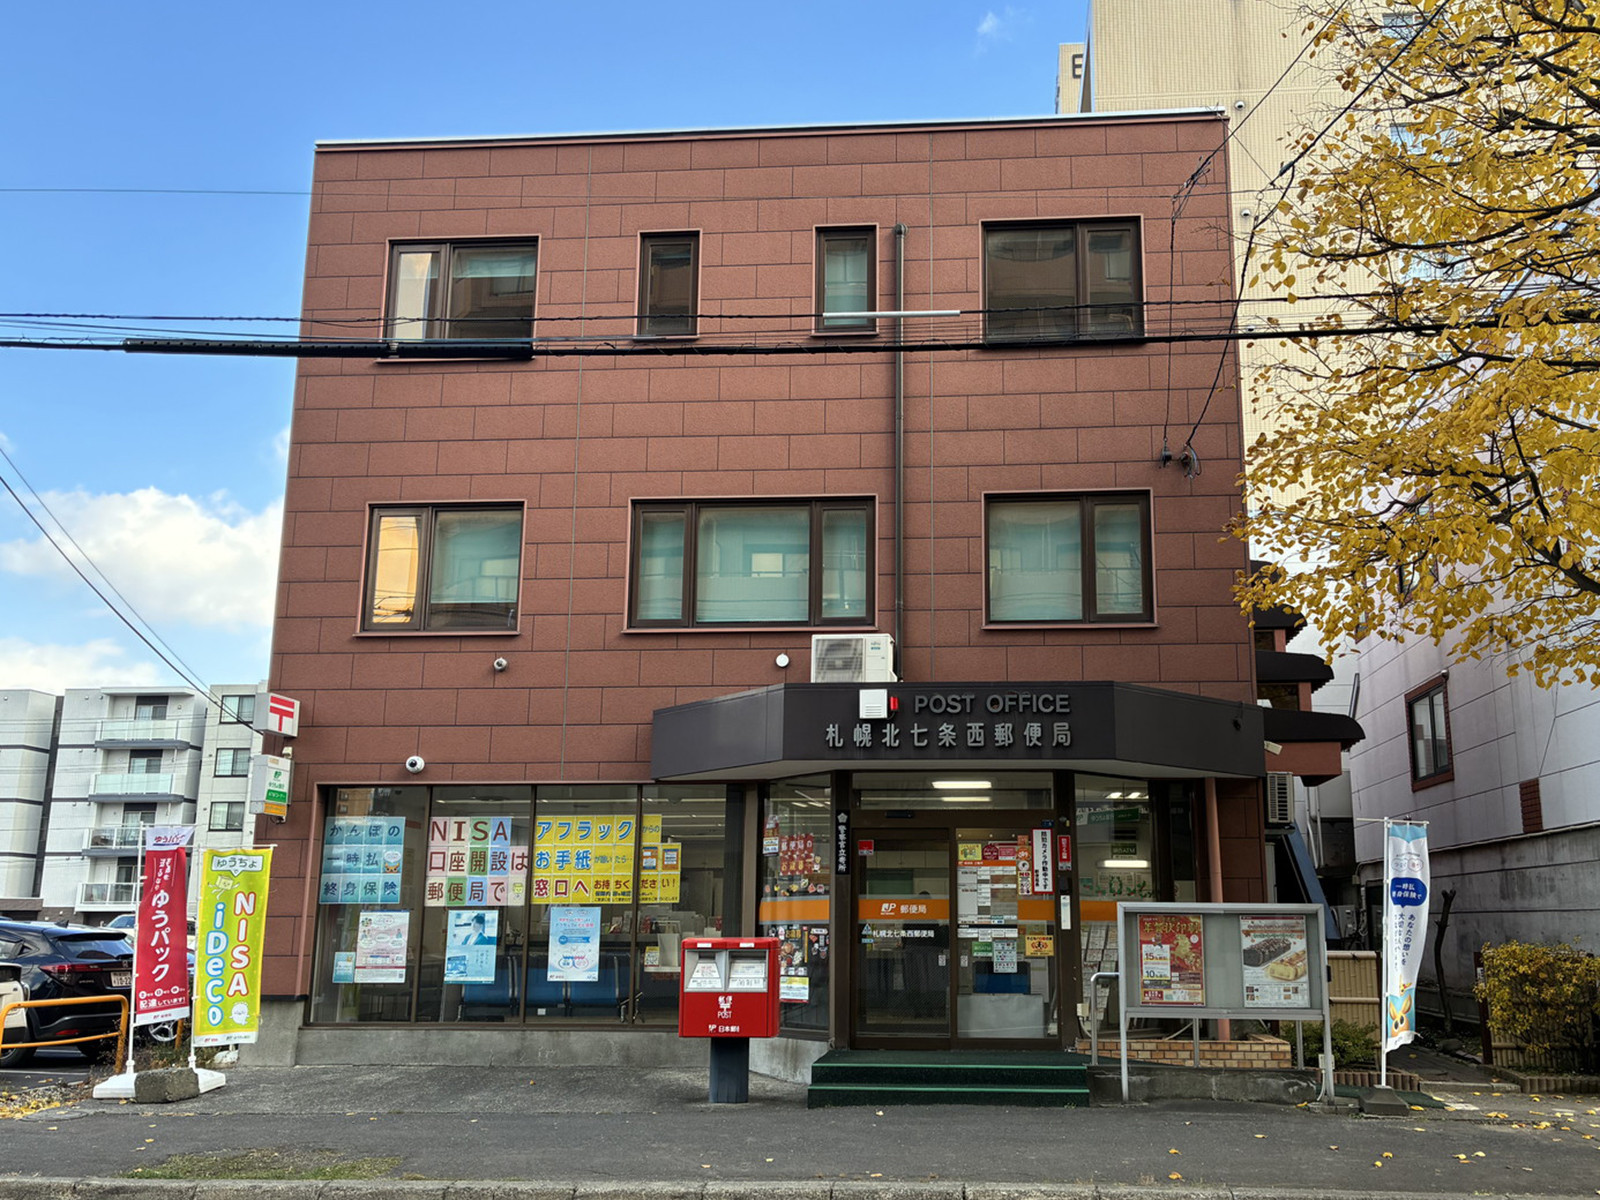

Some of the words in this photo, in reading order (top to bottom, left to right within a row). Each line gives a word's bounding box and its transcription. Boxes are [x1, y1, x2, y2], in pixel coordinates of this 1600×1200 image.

[915, 694, 975, 713] POST
[986, 694, 1071, 713] OFFICE
[826, 722, 1072, 748] 札幌北七条西郵便局
[329, 824, 400, 837] かんぽの
[430, 820, 508, 842] NISA
[537, 820, 633, 841] アフラック
[216, 856, 258, 869] ゆうちょ
[326, 851, 379, 868] 一時払
[429, 850, 529, 874] 口座開設は
[535, 849, 591, 871] お手紙
[323, 881, 398, 896] 終身保険
[427, 880, 507, 903] 郵便局で
[534, 879, 589, 897] 窓口へ
[900, 904, 927, 914] 郵便局
[151, 889, 171, 983] ゆうパック
[227, 891, 257, 997] NISA
[205, 901, 229, 1027] iDeCo
[717, 1011, 732, 1019] POST
